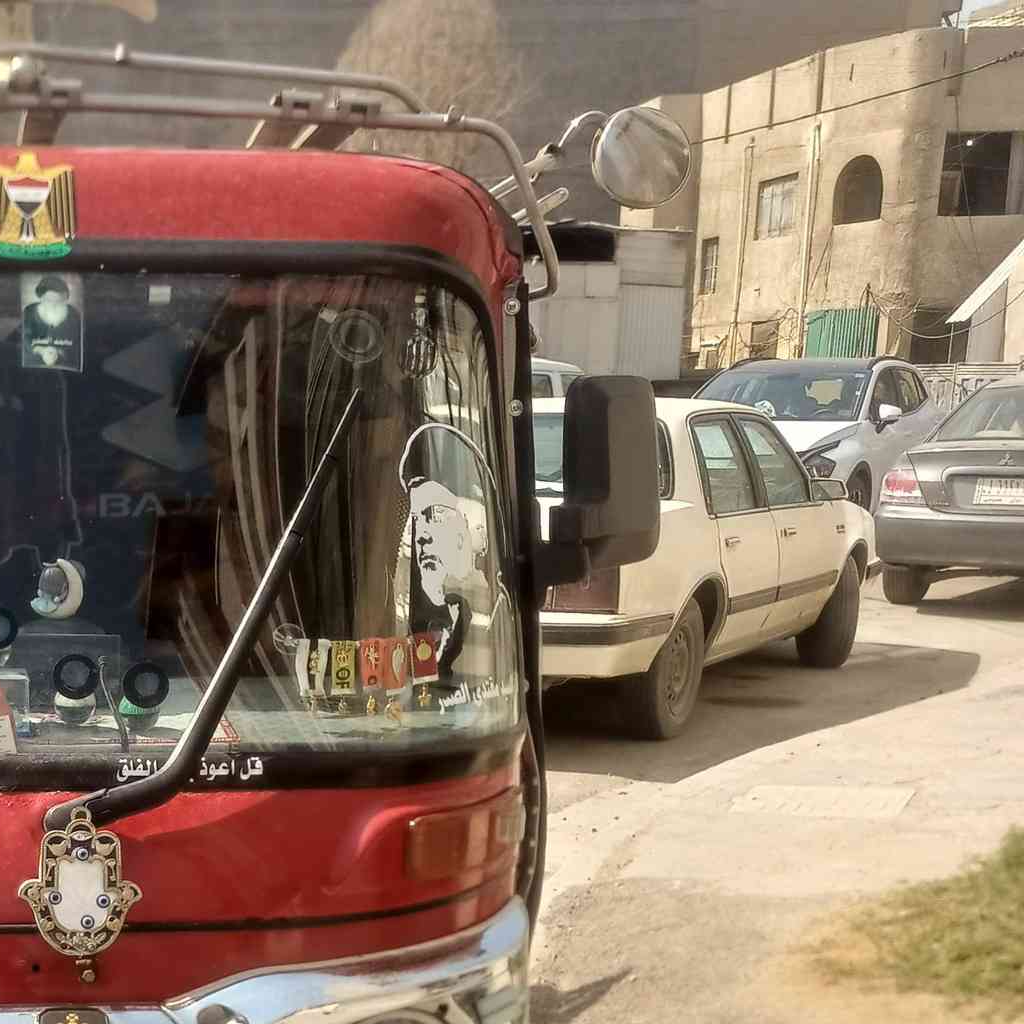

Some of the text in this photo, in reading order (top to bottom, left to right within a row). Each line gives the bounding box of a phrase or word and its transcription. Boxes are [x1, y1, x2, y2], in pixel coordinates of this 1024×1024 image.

[116, 758, 158, 782] الفلق
[199, 756, 235, 781] اعوذ
[239, 756, 264, 781] قل
